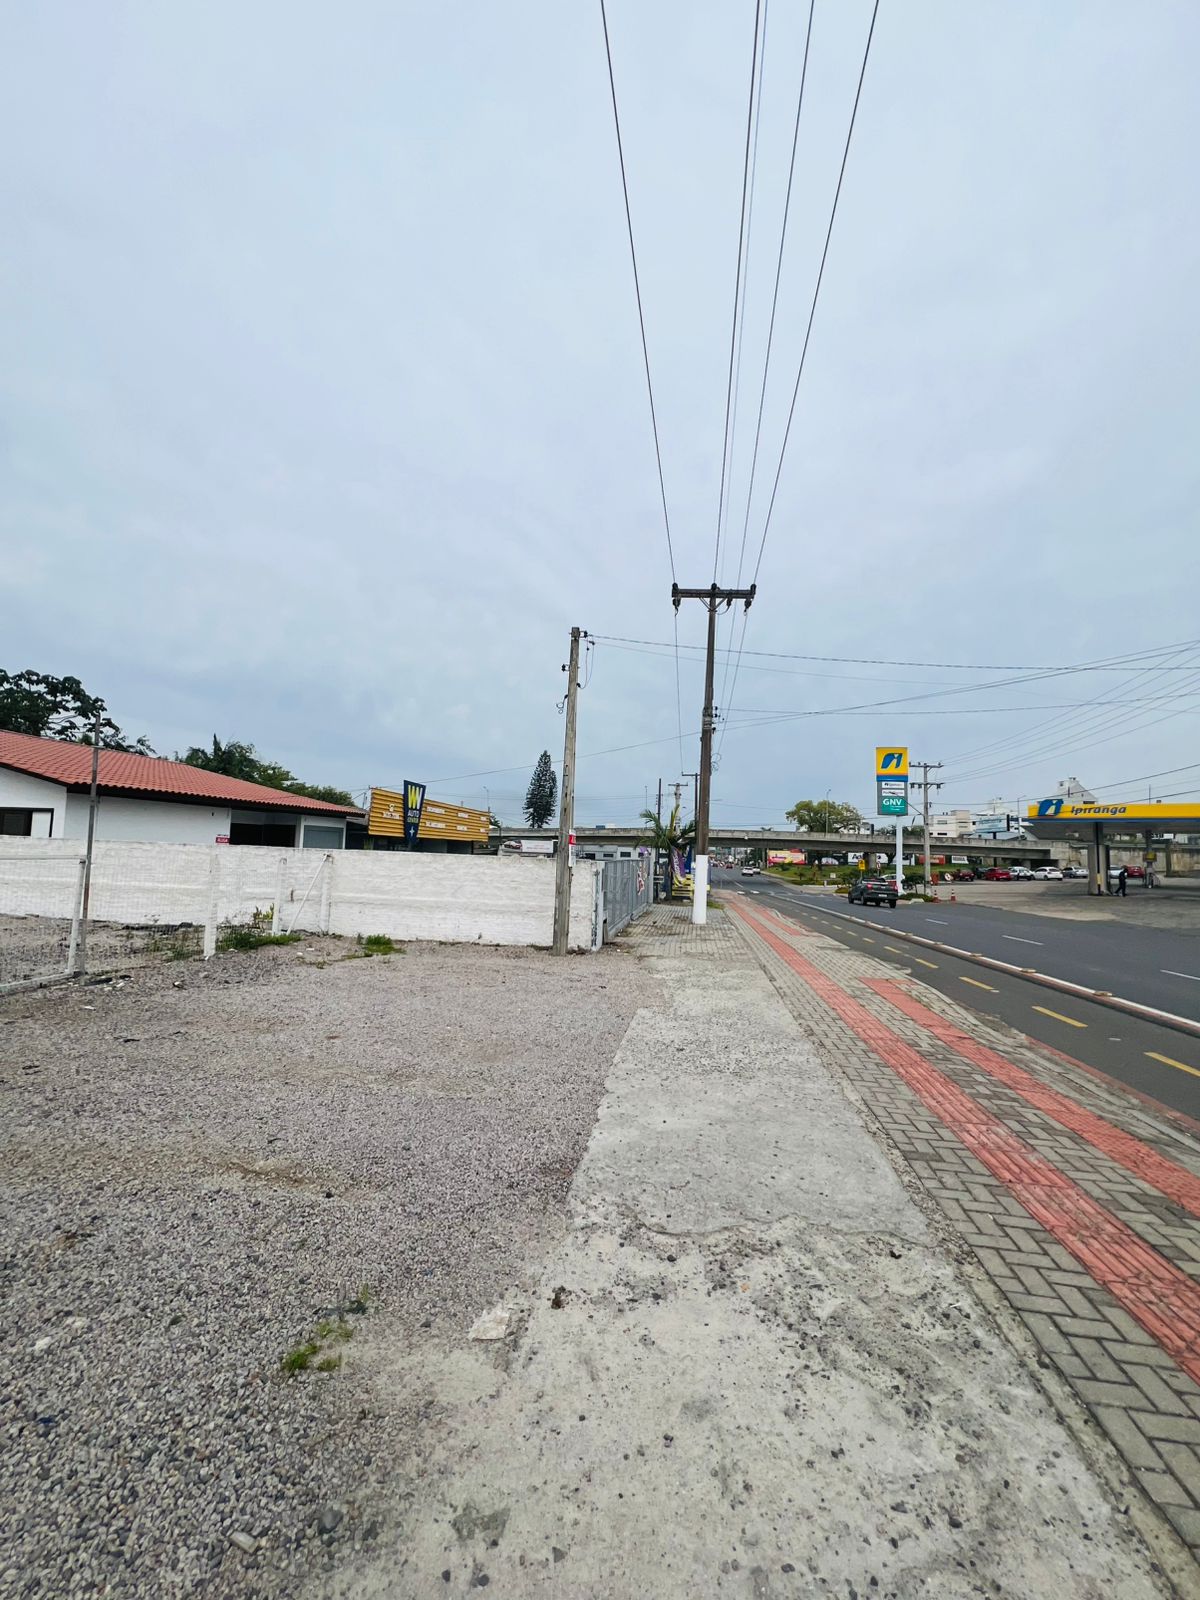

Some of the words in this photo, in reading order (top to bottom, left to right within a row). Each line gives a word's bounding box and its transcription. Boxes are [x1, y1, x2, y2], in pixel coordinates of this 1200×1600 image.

[882, 798, 902, 806] GNV
[407, 809, 420, 817] AUTO
[1071, 805, 1126, 816] Ipiranga
